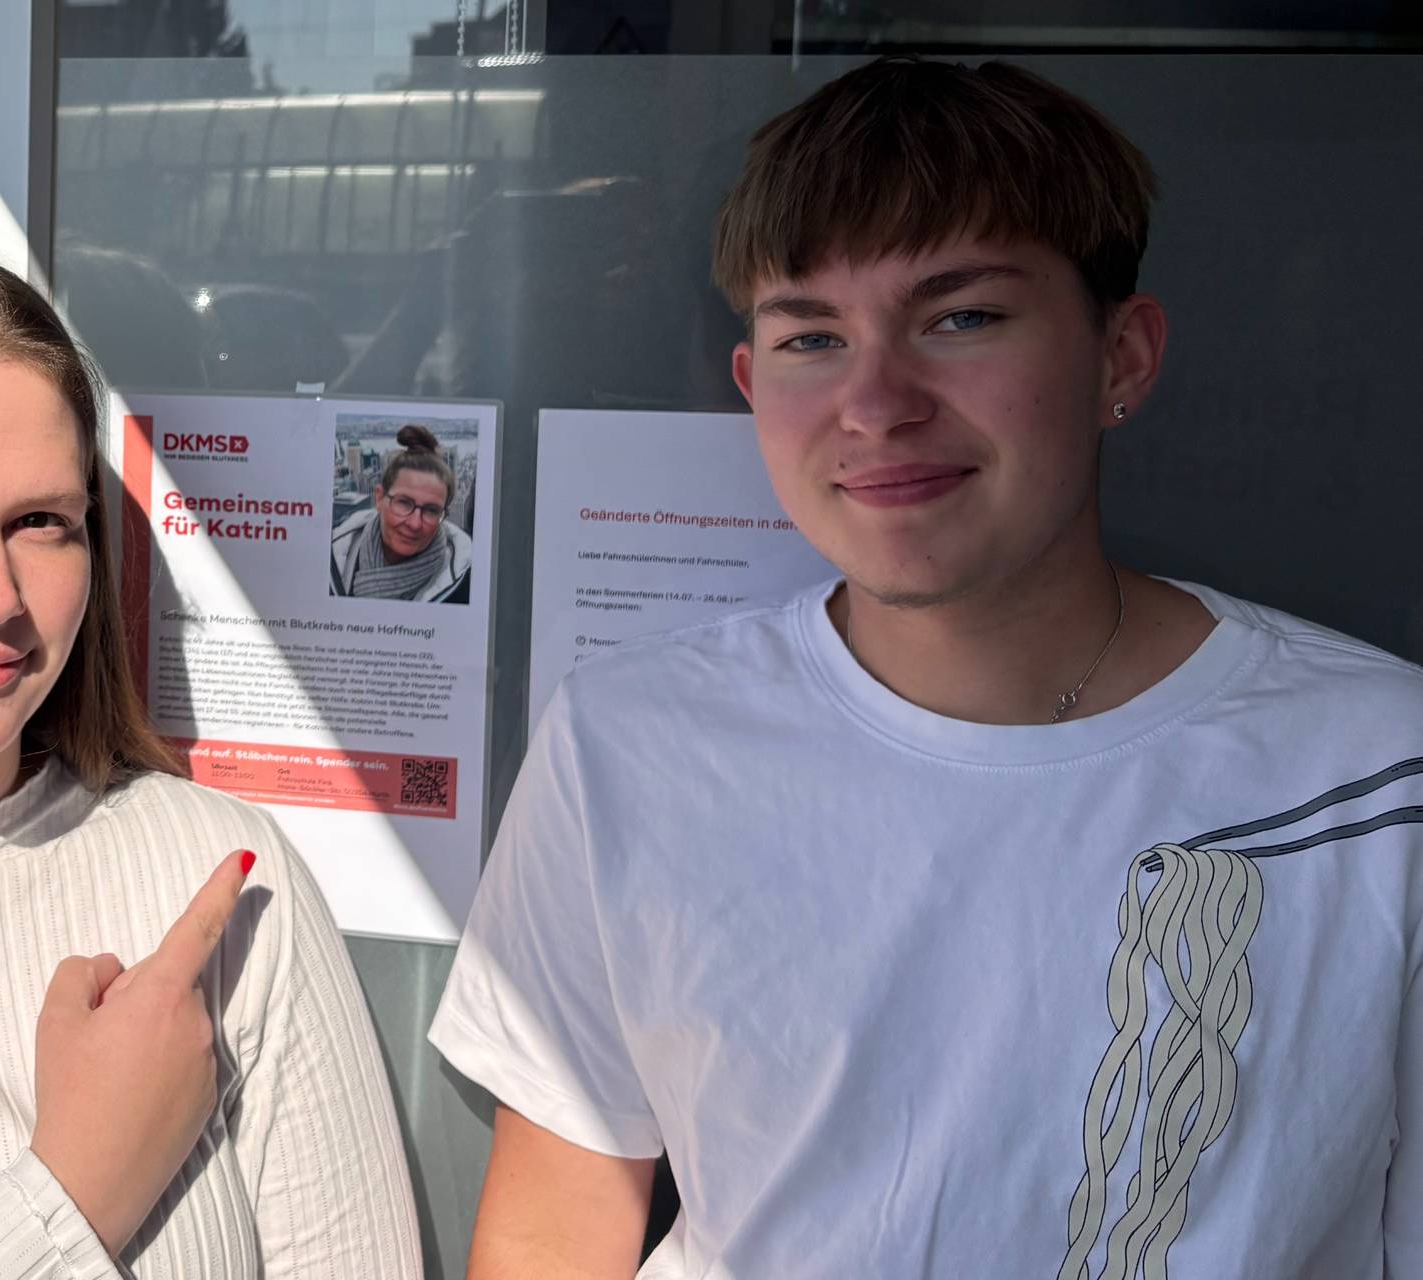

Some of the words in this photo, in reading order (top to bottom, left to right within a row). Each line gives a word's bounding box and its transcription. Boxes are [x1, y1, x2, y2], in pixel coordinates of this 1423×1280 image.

[164, 433, 228, 452] DKMS
[164, 491, 313, 516] Gemeinsam
[163, 516, 200, 535] für
[207, 518, 288, 541] Katrin
[580, 507, 650, 524] Geänderte
[653, 510, 754, 529] Öffnungszeiten
[757, 519, 769, 529] in
[578, 551, 601, 560] Liebe
[603, 552, 676, 564] Fahrschülerinnen
[678, 556, 695, 566] und
[697, 556, 750, 568] Fahrschüler,
[576, 599, 642, 612] Öffnungszeiten:
[586, 589, 602, 597] den
[604, 589, 663, 600] Sommerferien
[160, 610, 207, 624] Schenke
[209, 614, 266, 627] Menschen
[268, 618, 287, 628] mit
[290, 618, 344, 632] Blutkrebs
[346, 624, 374, 634] neue
[377, 624, 435, 639] Hoffnung!
[212, 748, 234, 758] auf.
[235, 749, 288, 762] Stäbchen
[289, 754, 313, 765] rein.
[316, 756, 361, 768] Spender
[363, 760, 389, 771] sein.
